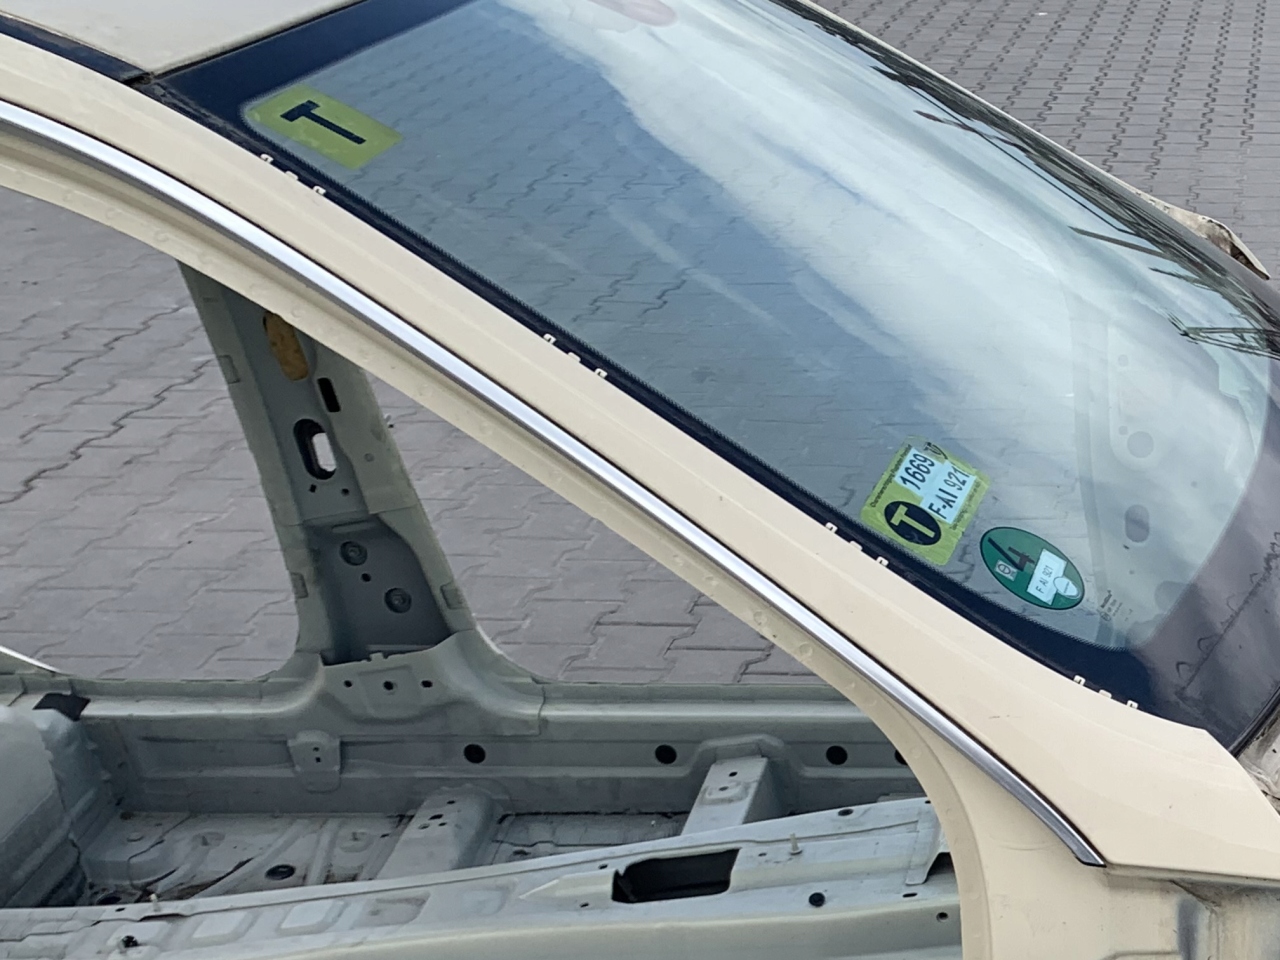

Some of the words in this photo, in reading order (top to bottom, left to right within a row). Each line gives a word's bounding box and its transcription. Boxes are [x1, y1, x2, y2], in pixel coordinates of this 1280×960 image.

[280, 100, 366, 145] T
[900, 453, 935, 490] 1669
[943, 465, 970, 491] 921
[890, 504, 936, 539] T
[988, 537, 1035, 572] 4
[1035, 586, 1045, 594] F
[1042, 565, 1054, 578] 921
